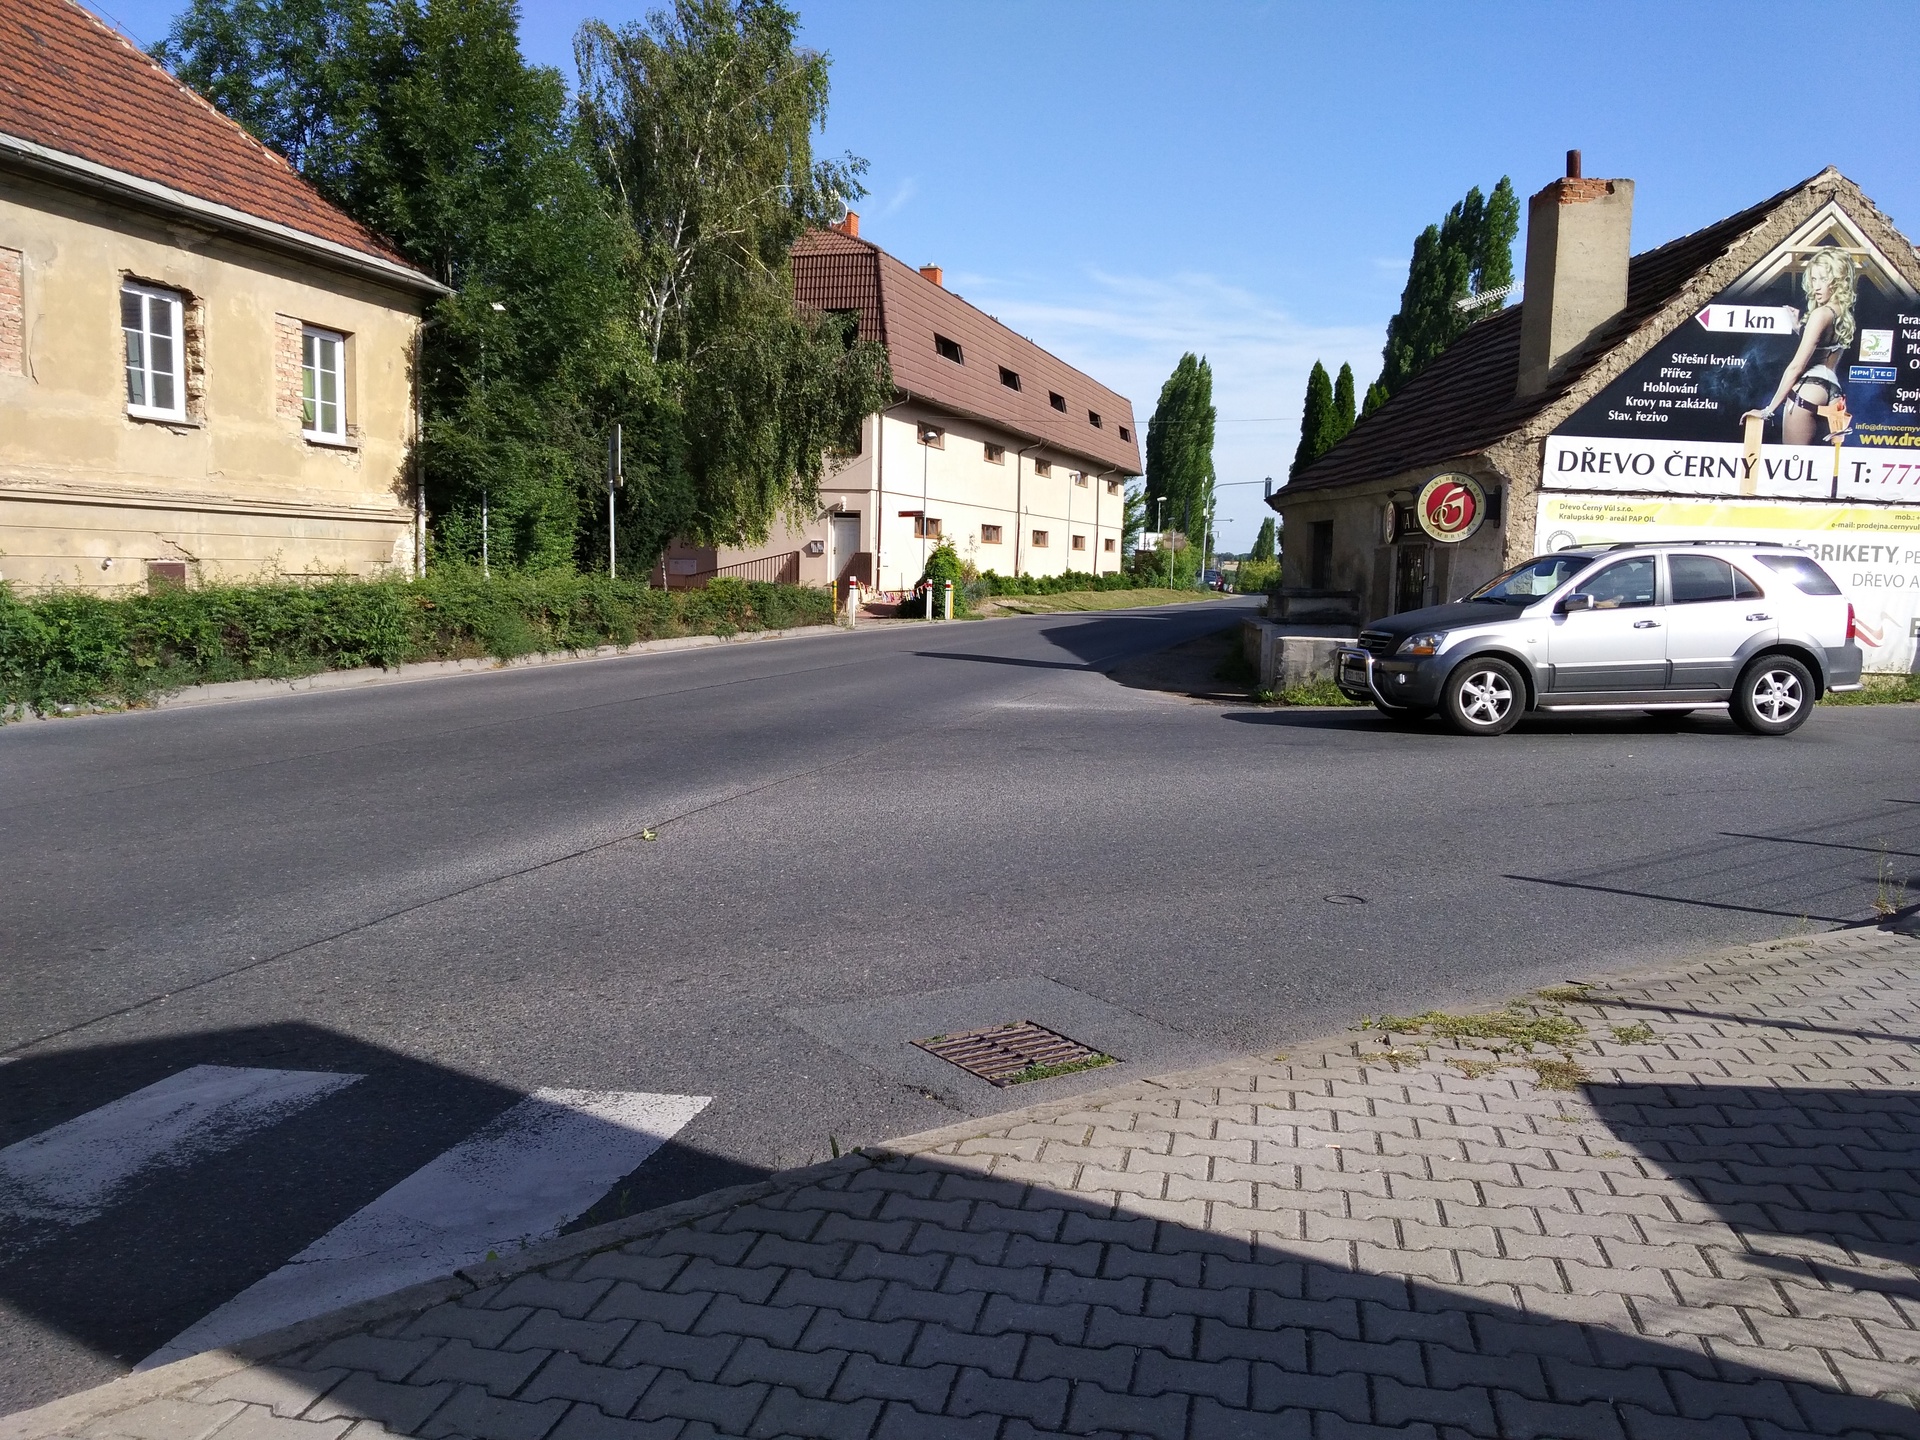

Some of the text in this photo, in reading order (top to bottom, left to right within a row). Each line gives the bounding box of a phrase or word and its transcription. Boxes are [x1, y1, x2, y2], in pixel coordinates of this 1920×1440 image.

[1726, 309, 1775, 329] 1 km
[1671, 352, 1747, 369] Střešní krytiny
[1660, 367, 1692, 379] Přířez
[1643, 381, 1699, 394] Hoblování
[1625, 396, 1718, 410] Krovy na zakázku
[1892, 402, 1917, 413] Stav.
[1608, 410, 1669, 423] Stav. řezivo
[1557, 446, 1655, 476] DŘEVO
[1664, 450, 1758, 480] ČERNÝ
[1764, 454, 1818, 482] VŮL
[1850, 461, 1872, 484] T:
[1559, 503, 1581, 511] Dřevo
[1582, 503, 1603, 512] Černý
[1603, 504, 1616, 512] Vůl
[1558, 512, 1594, 522] Kralupská
[1852, 570, 1905, 588] DŘEVO
